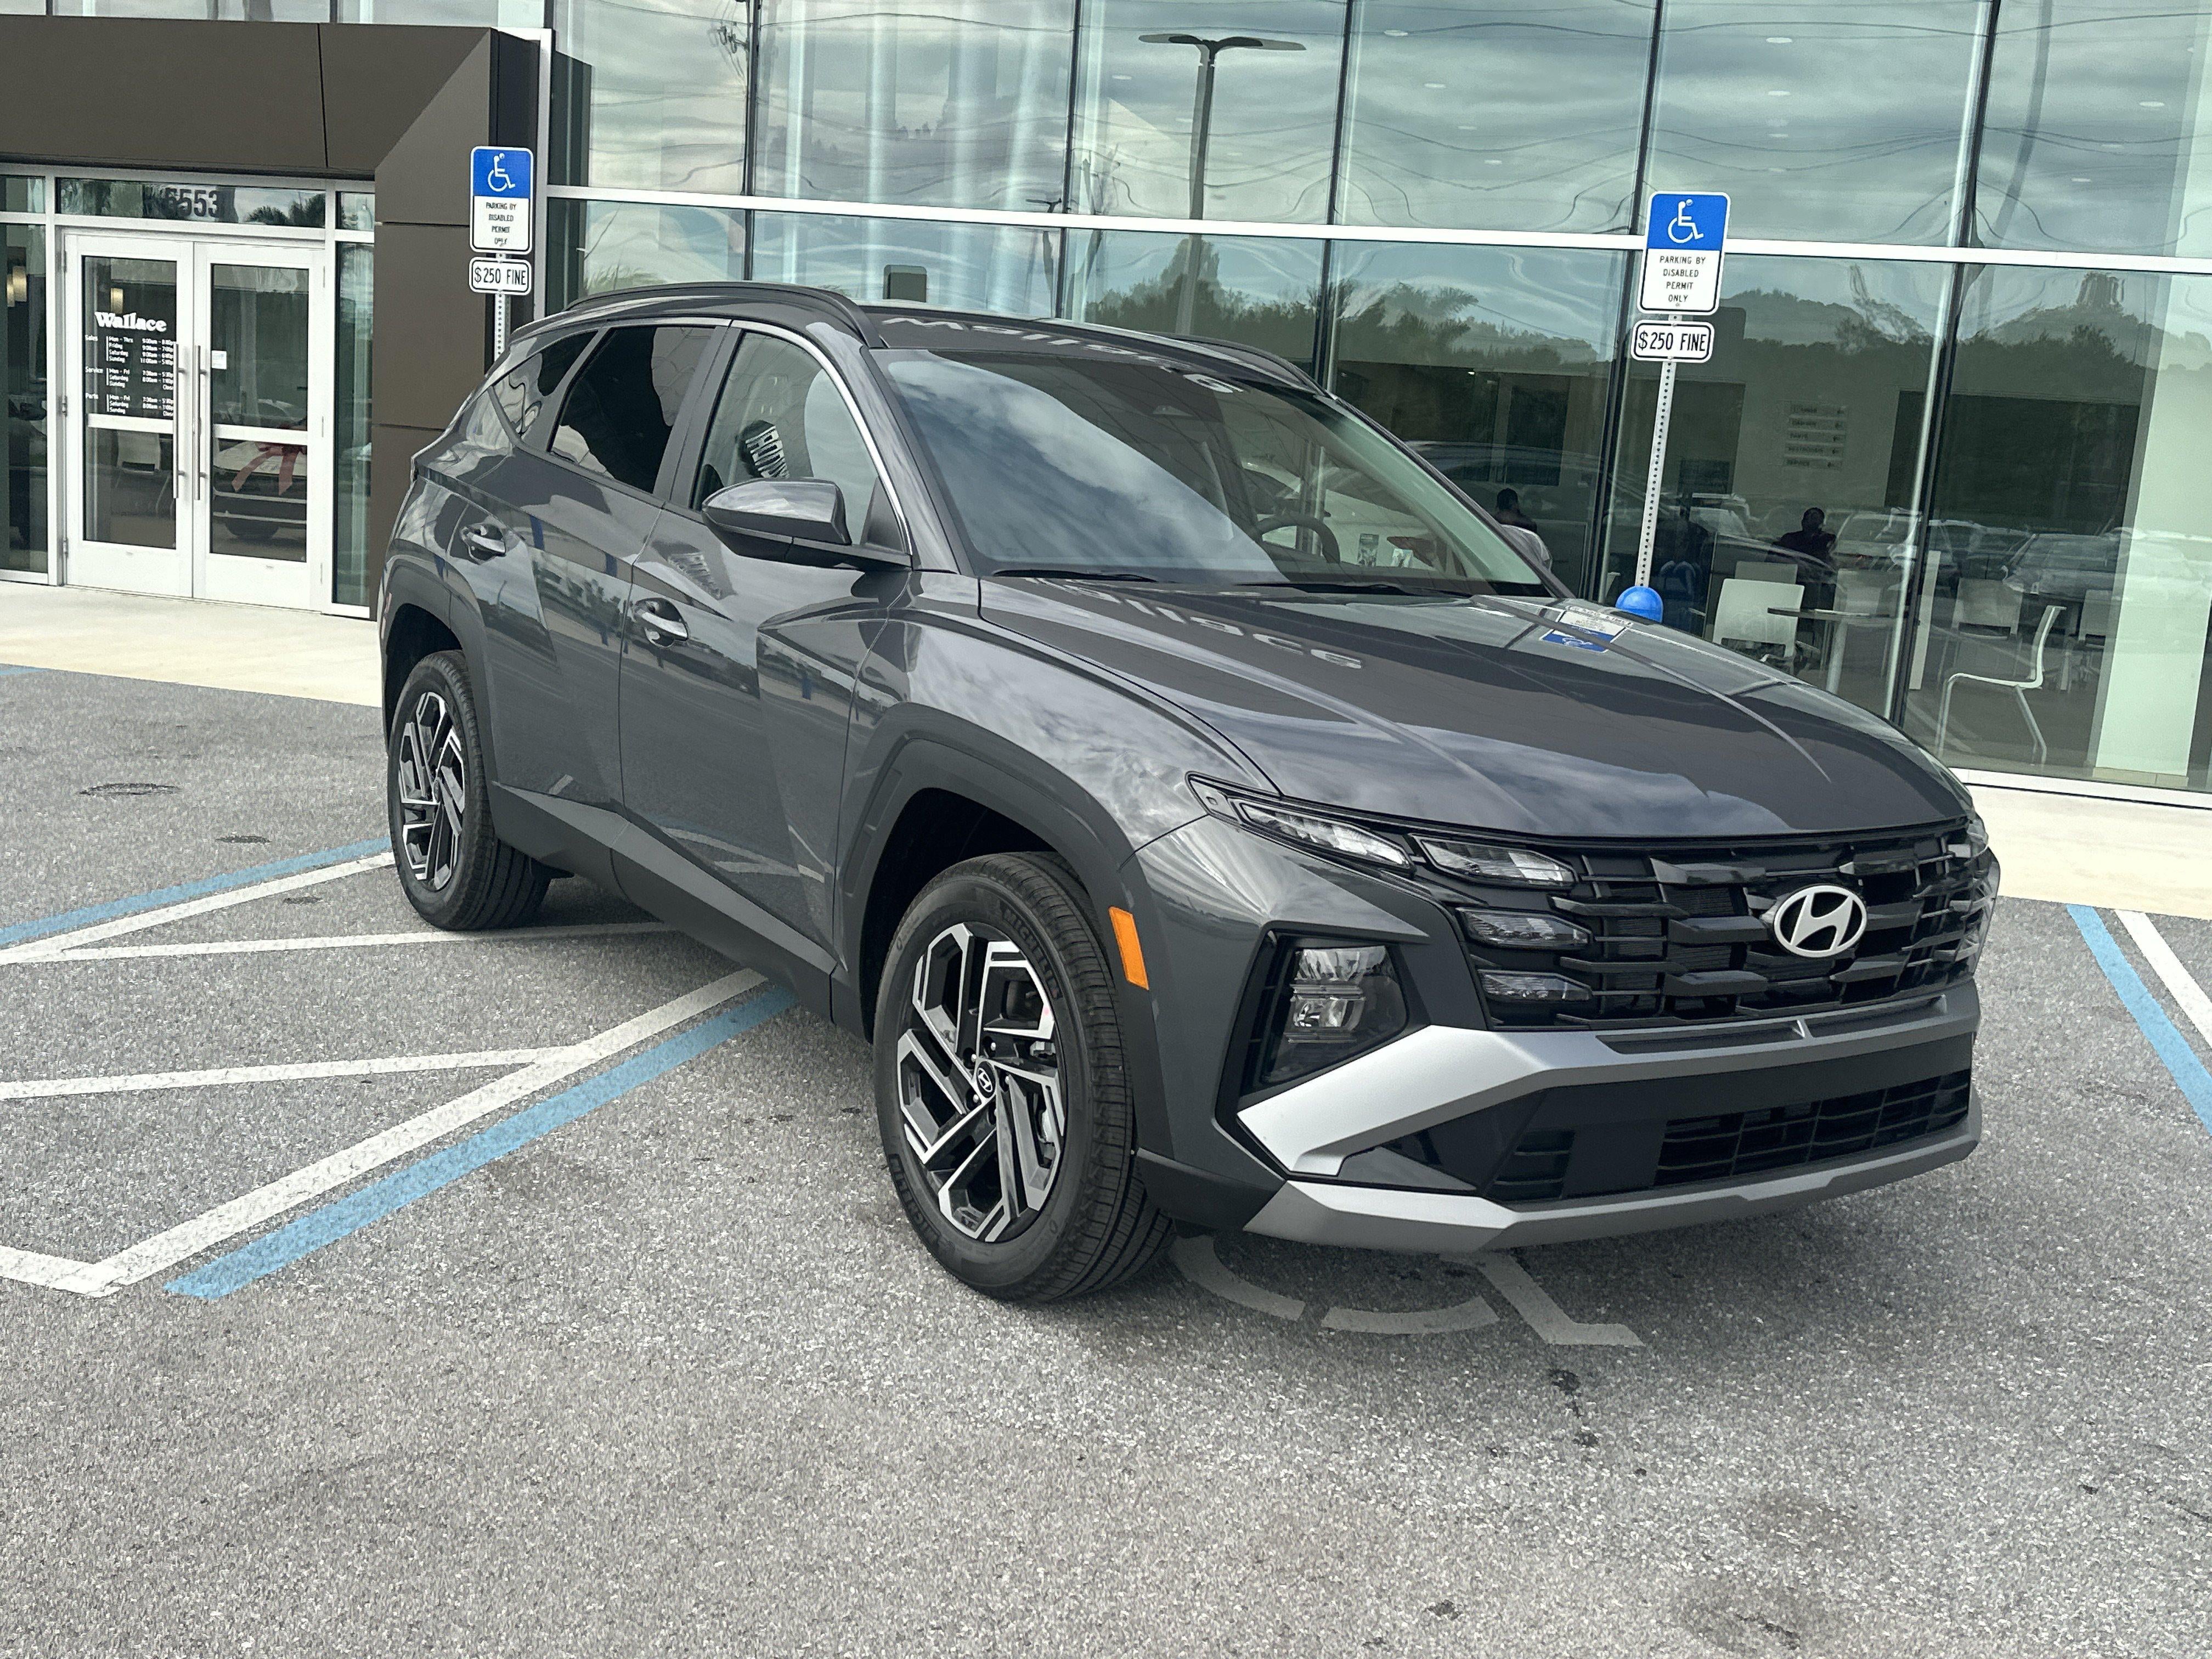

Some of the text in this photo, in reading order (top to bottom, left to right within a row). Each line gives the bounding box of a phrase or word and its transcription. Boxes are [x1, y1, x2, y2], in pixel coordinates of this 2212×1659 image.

[1660, 256, 1692, 264] PARKING
[474, 266, 527, 285] $250 FINE
[1663, 269, 1699, 278] DISABLED
[1666, 281, 1694, 290] PERMIT
[94, 312, 167, 332] Wallace
[1638, 330, 1707, 352] $250 FINE
[1003, 908, 1060, 1000] MICHELIN
